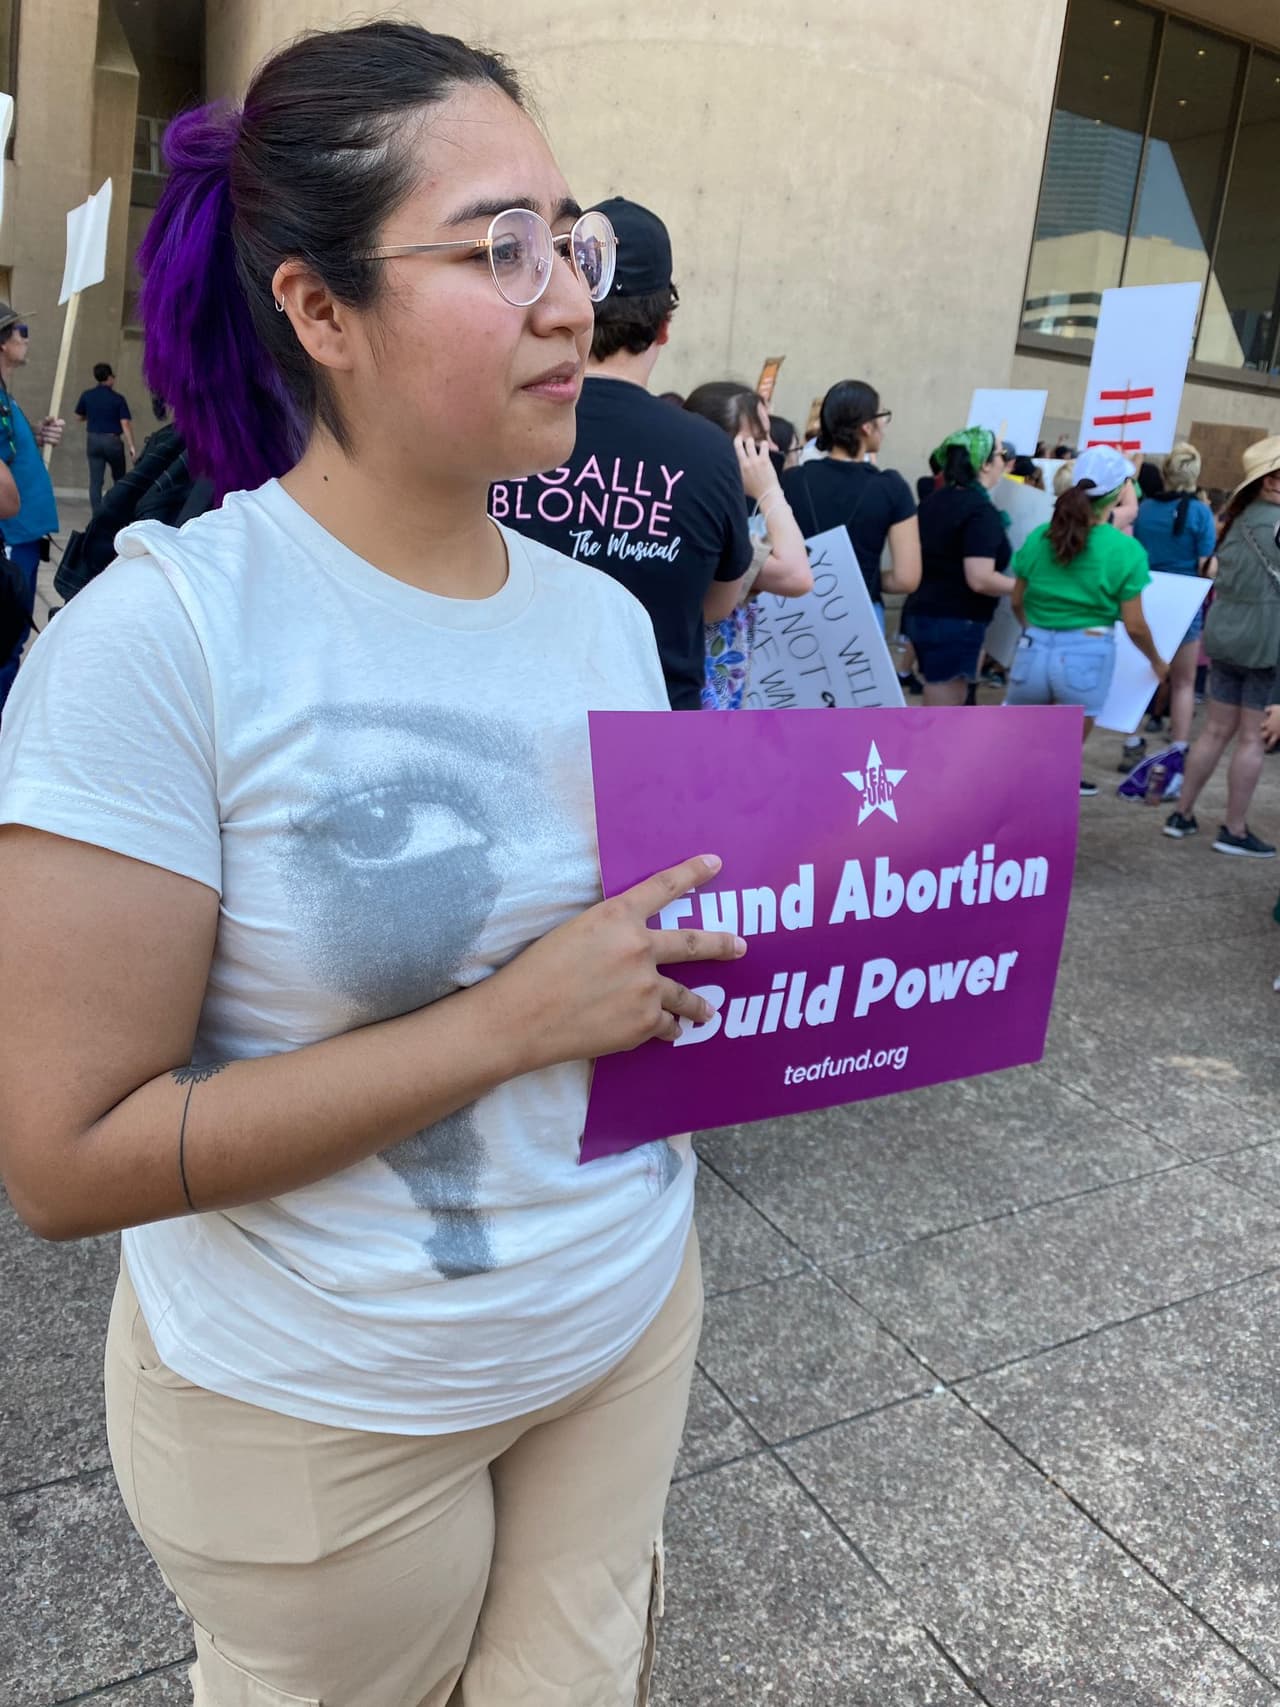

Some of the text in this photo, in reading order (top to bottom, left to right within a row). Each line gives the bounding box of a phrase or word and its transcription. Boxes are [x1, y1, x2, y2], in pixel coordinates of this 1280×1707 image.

[492, 484, 673, 537] BLONDE
[569, 529, 682, 563] The Musical
[775, 611, 832, 686] NOT
[828, 844, 1049, 924] Abortion
[673, 951, 1019, 1047] Build Power
[784, 1045, 909, 1085] teafund.org
